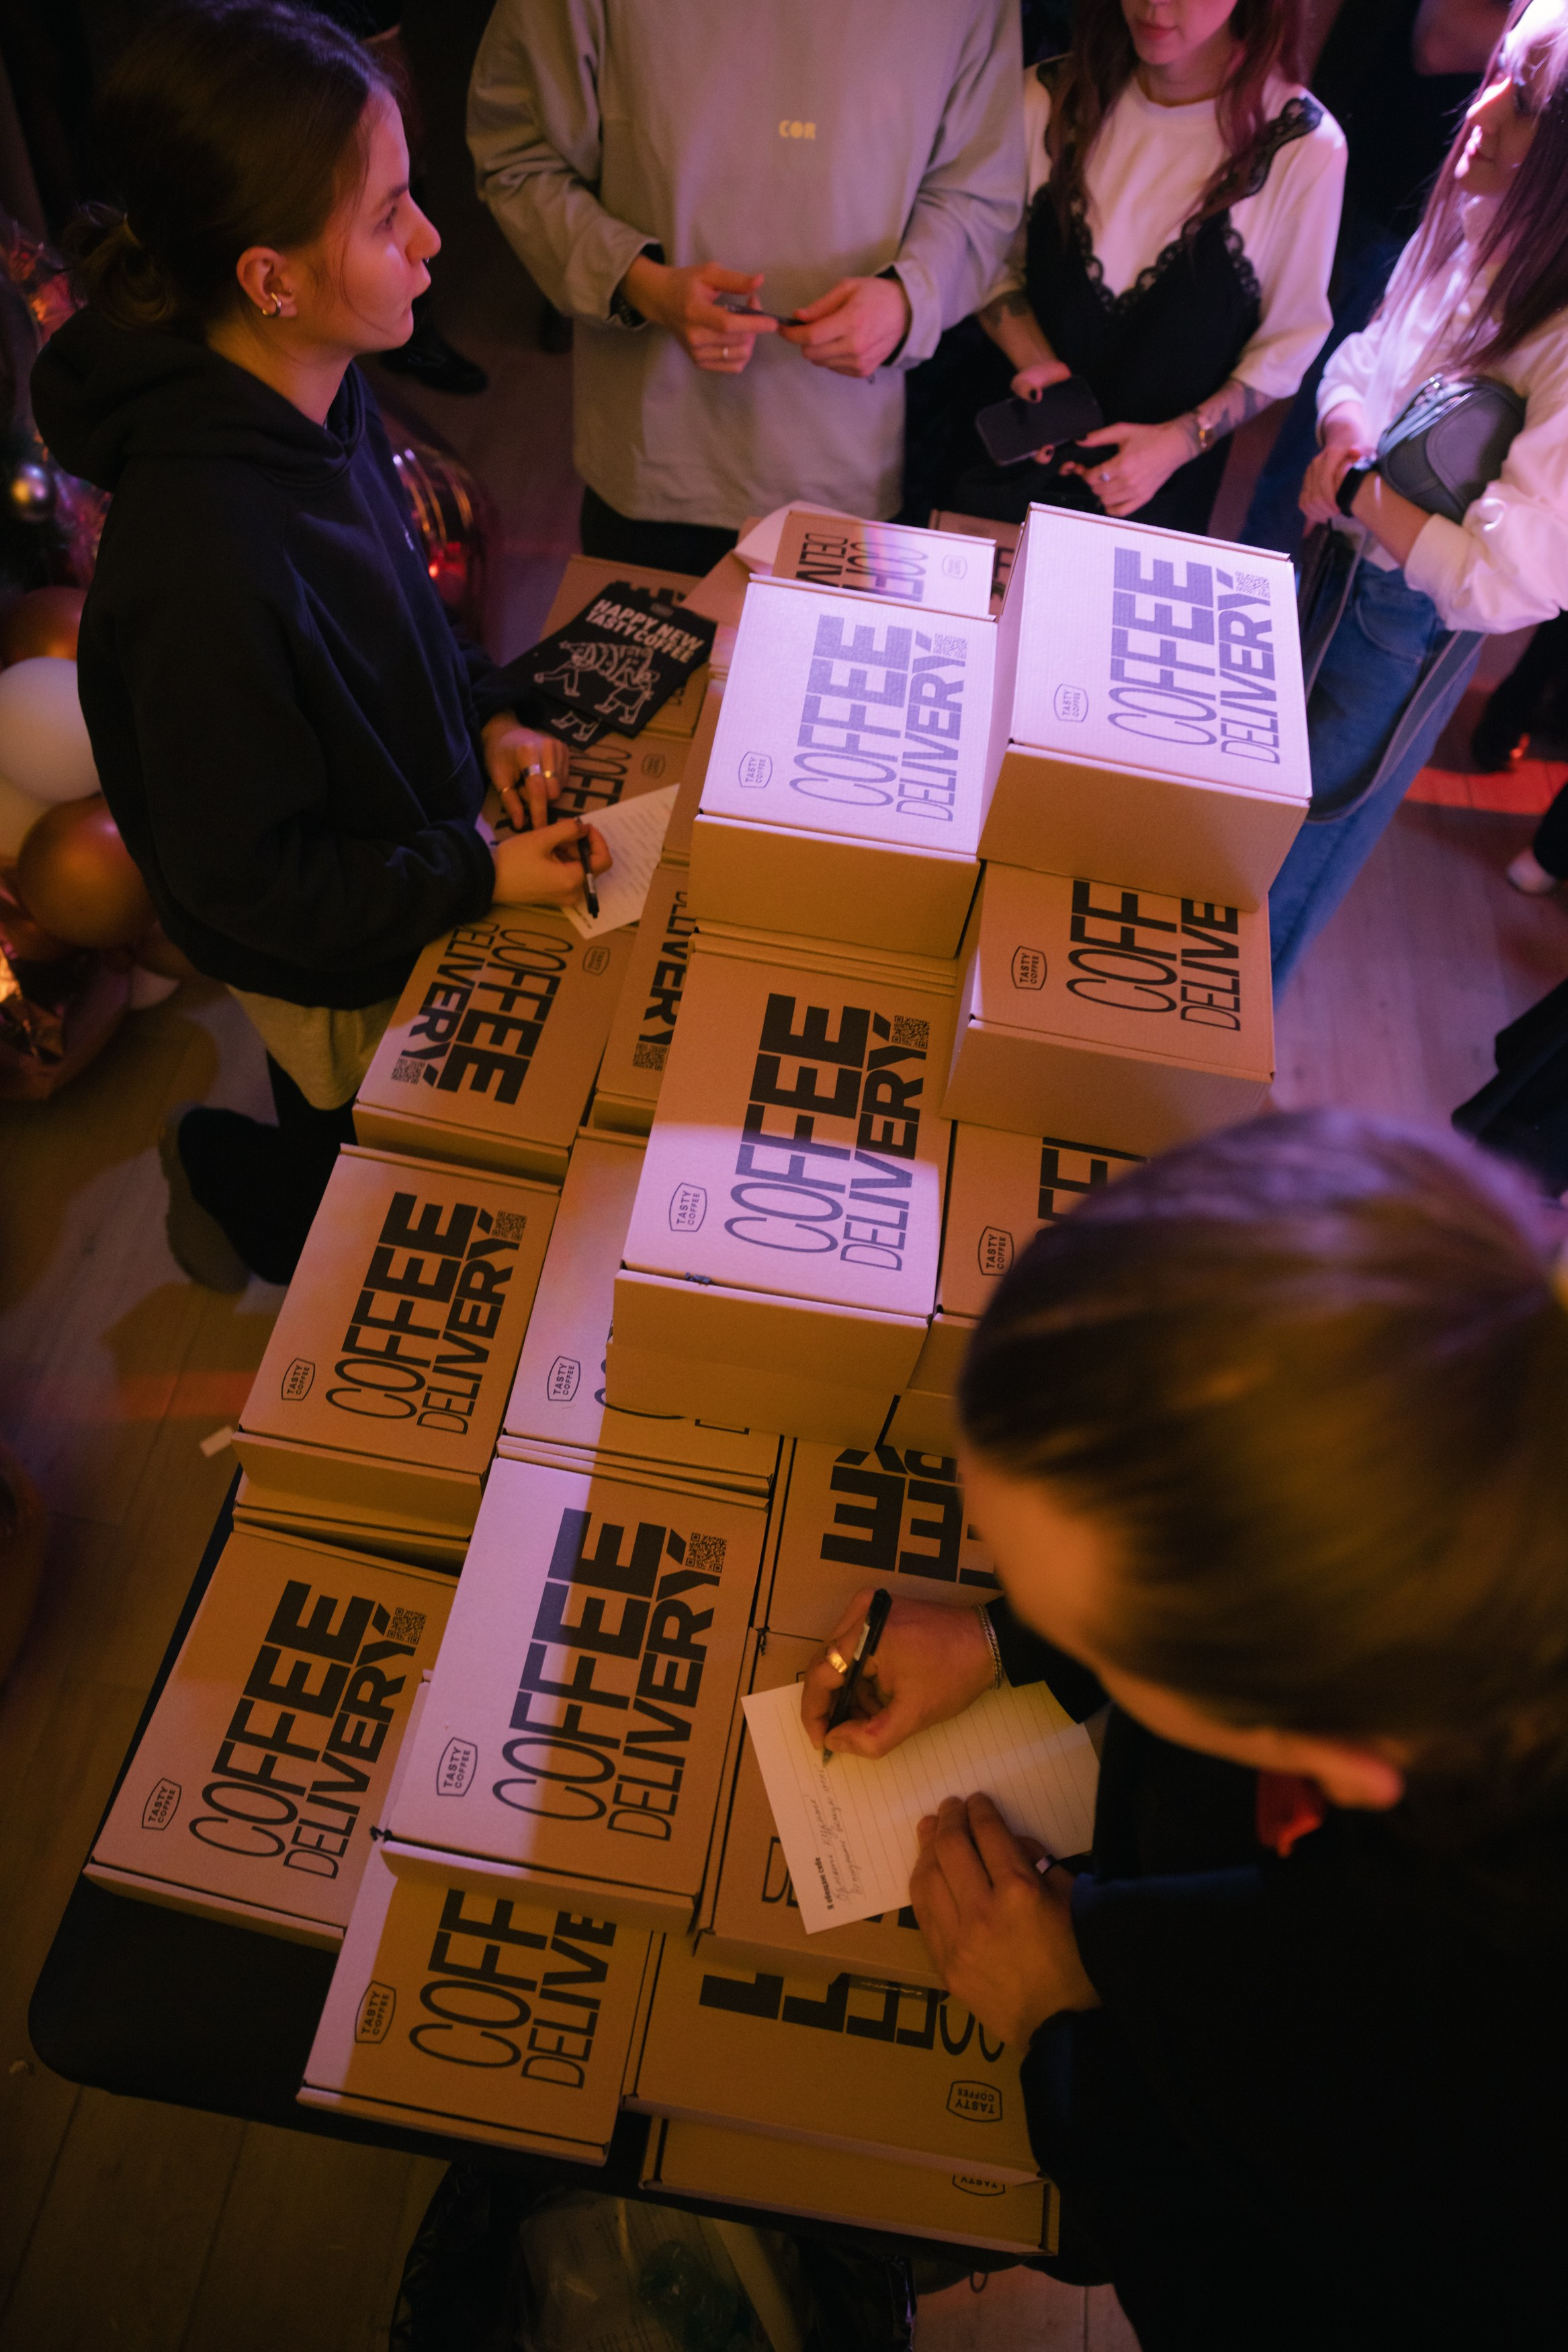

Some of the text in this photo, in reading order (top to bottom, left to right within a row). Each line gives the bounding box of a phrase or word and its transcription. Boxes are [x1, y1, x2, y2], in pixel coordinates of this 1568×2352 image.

[795, 533, 848, 587] DELIV
[842, 542, 928, 602] COF
[593, 598, 659, 632] HAPPY
[656, 622, 705, 650] NEW
[1108, 547, 1217, 745] COFFEE
[1216, 568, 1280, 765] DELIVERY
[789, 614, 913, 807] COFFEE
[896, 630, 967, 822] DELIVERY
[745, 756, 758, 782] TASTY
[755, 759, 766, 784] COFFEE
[1019, 953, 1031, 983] TASTY
[1065, 880, 1178, 1013] COFF
[1180, 897, 1241, 1032] DELIVE
[1031, 955, 1039, 984] COFFEE
[436, 929, 574, 1105] COFFEE
[724, 993, 871, 1253] COFFEE
[840, 1011, 927, 1271] DELIVERY
[677, 1190, 691, 1225] TASTY
[687, 1193, 700, 1226] COFFEE
[986, 1234, 997, 1269] TASTY
[996, 1236, 1006, 1269] COFFEE
[325, 1191, 478, 1420] COFFEE
[416, 1208, 520, 1435] DELIVERY
[287, 1364, 303, 1394] TASTY
[296, 1367, 310, 1395] COFFEE
[552, 1363, 567, 1395] TASTY
[562, 1365, 575, 1396] COFFEE
[492, 1507, 667, 1821] COFFEE
[607, 1528, 722, 1841] DELIVERY
[189, 1579, 376, 1858] COFFEE
[283, 1603, 417, 1880] DELIVERY
[444, 1747, 462, 1788] TASTY
[454, 1750, 471, 1789] COFFEE
[148, 1786, 168, 1822] TASTY
[157, 1789, 176, 1824] COFFEE
[815, 1857, 824, 1874] себе
[820, 1874, 833, 1903] обещаю
[408, 1888, 548, 2068] COFF
[361, 1990, 380, 2034] TASTY
[373, 1993, 389, 2035] COFFEE
[521, 1911, 617, 2089] DELIVE
[955, 2099, 994, 2114] TASTY
[957, 2088, 994, 2101] COFFEE
